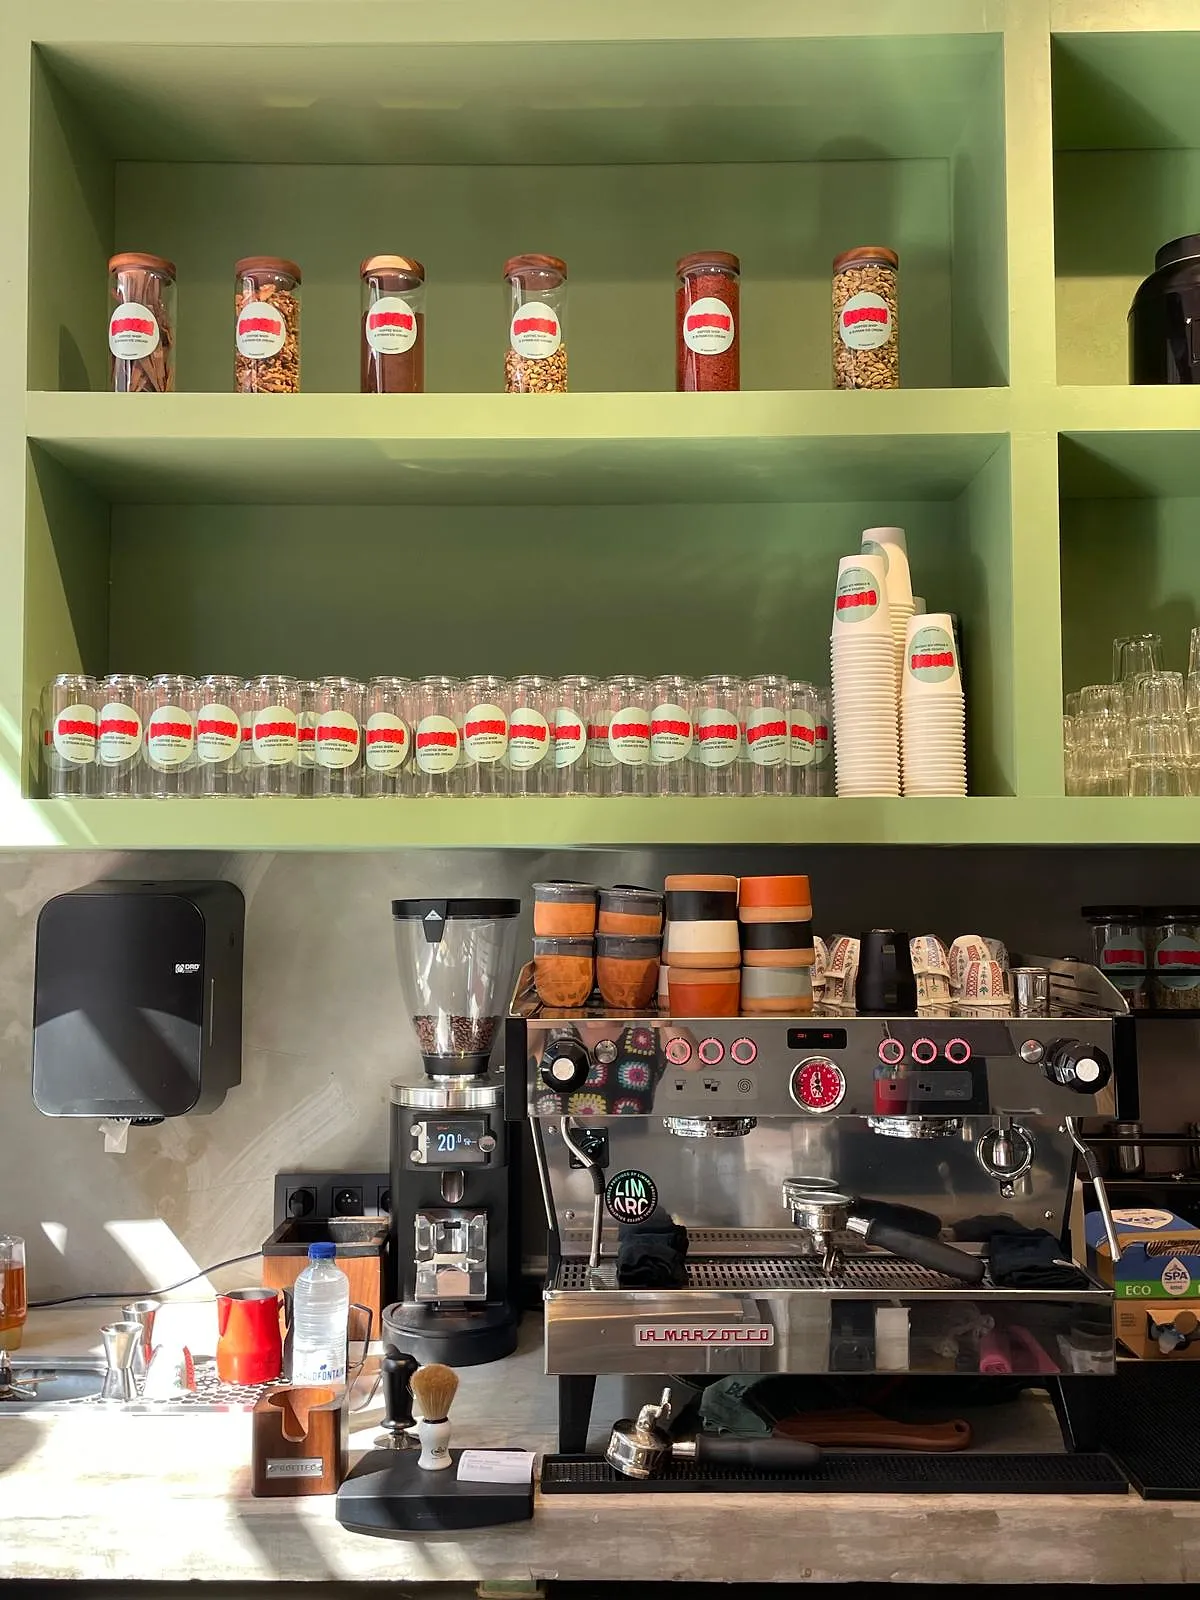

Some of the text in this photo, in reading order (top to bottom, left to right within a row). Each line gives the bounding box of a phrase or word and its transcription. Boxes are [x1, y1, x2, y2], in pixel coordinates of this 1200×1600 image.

[615, 1178, 646, 1198] LIM
[1164, 1271, 1189, 1281] SPA
[1125, 1285, 1152, 1296] ECO
